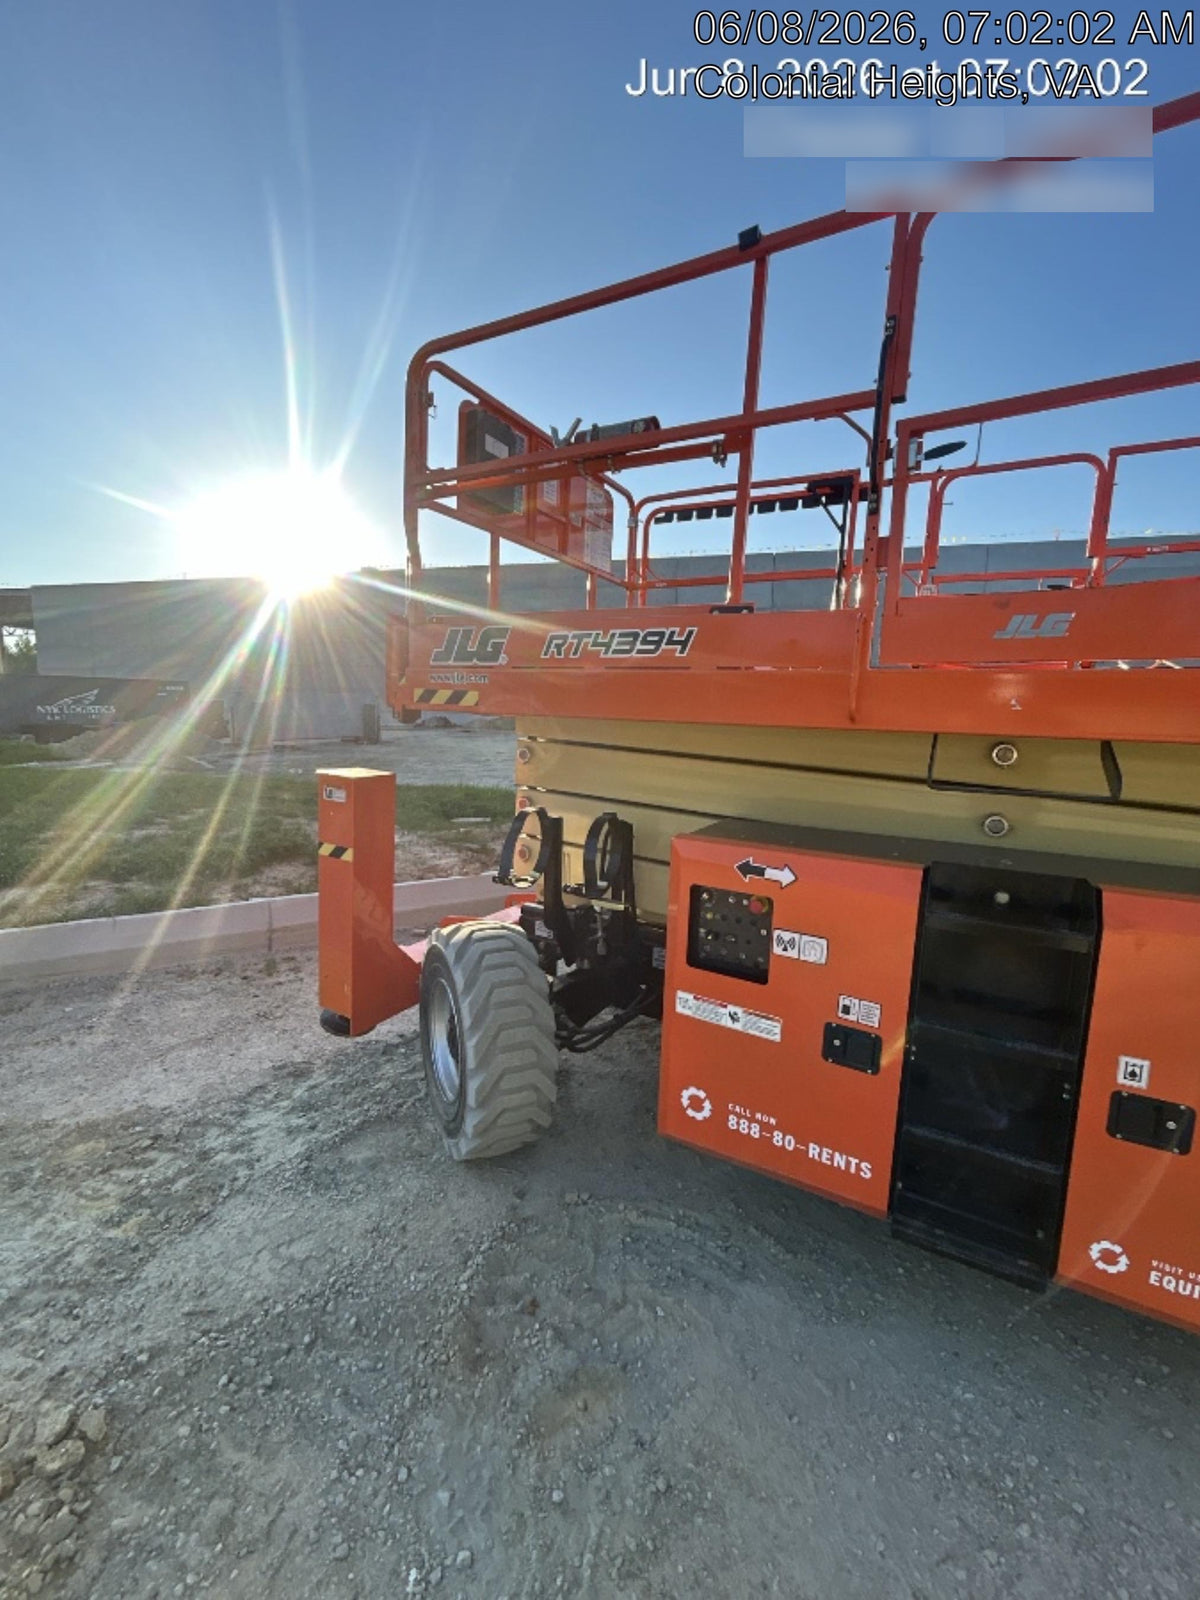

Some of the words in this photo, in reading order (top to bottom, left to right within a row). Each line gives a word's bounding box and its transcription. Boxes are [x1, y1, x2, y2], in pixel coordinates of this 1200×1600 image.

[993, 612, 1075, 639] JLG
[429, 625, 512, 666] JLG
[541, 627, 697, 658] RT4394
[728, 1103, 751, 1118] CALL
[755, 1112, 777, 1126] NOW
[728, 1114, 872, 1179] 888-80-RENTS
[1151, 1259, 1184, 1275] VISIT
